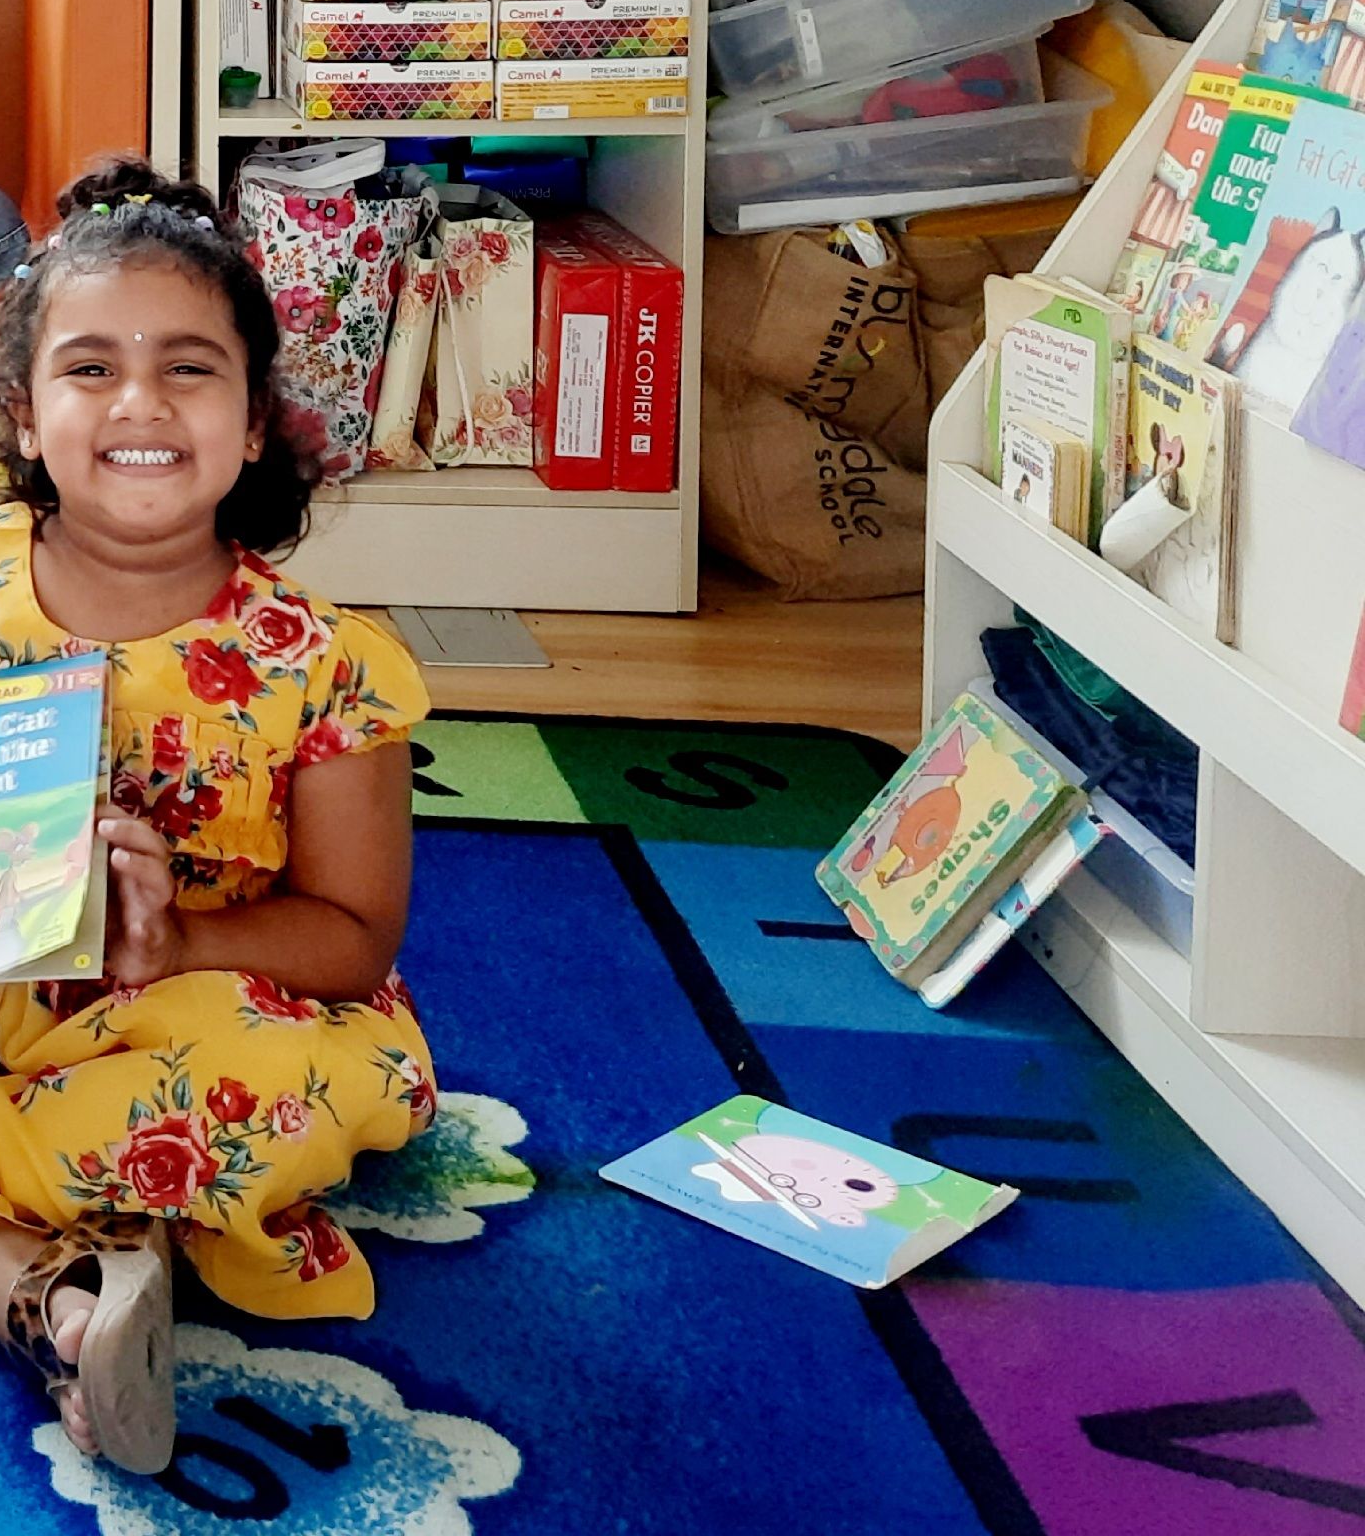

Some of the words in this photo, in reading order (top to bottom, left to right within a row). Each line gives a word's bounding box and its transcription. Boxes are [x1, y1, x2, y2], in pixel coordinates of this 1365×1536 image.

[310, 11, 349, 22] Camel
[509, 8, 548, 19] Camel
[315, 71, 353, 82] Camel
[508, 70, 547, 81] Camel
[1296, 139, 1325, 178] Fat
[1328, 150, 1358, 190] Cat
[1211, 175, 1242, 206] the
[636, 308, 658, 346] JK
[633, 350, 655, 424] COPIER
[814, 448, 854, 547] SCHOOL
[625, 750, 789, 810] S
[910, 798, 1011, 916] Shapes
[156, 1395, 352, 1522] 10
